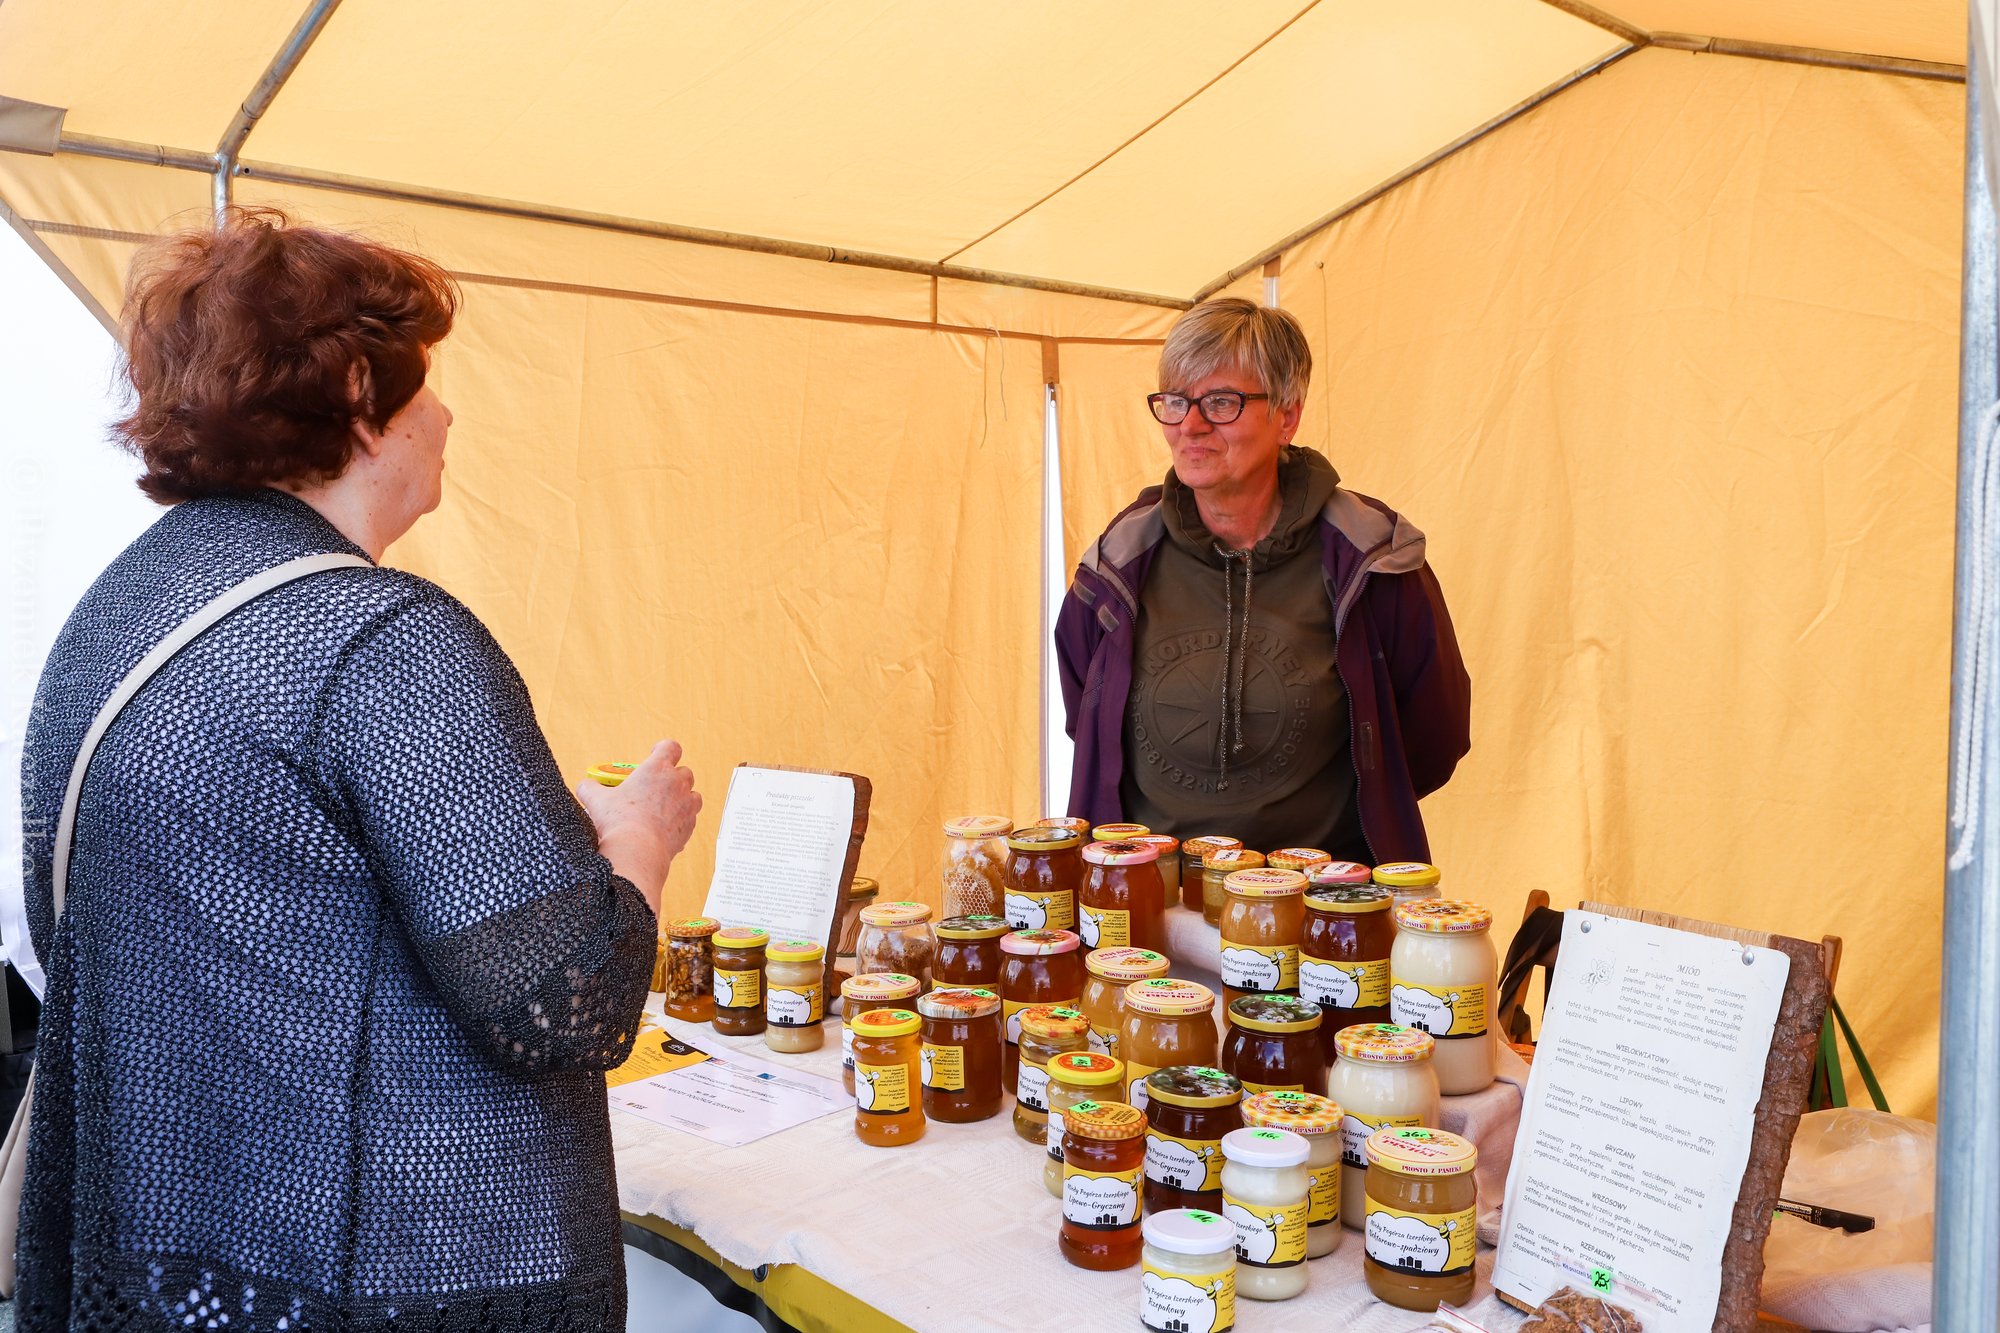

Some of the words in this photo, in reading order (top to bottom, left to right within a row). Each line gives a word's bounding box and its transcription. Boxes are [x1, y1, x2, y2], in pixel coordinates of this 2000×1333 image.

[1139, 630, 1312, 689] NORDRNEY
[1676, 963, 1701, 975] MIÓD
[1398, 1004, 1426, 1020] Rzepakowy
[1358, 1052, 1383, 1060] PROSTO
[1614, 1042, 1670, 1066] WIELOKWIATOWY
[1618, 1095, 1643, 1110] LIPOWY
[1604, 1142, 1636, 1161] GRYCZANY
[1401, 1165, 1428, 1174] PROSTO
[1437, 1166, 1462, 1174] PASIEKI
[1079, 1189, 1101, 1198] Pogórza
[1103, 1191, 1129, 1199] Izerskiego
[1590, 1190, 1627, 1212] WRZOSOWY
[1068, 1195, 1125, 1212] Lipowo-Gryczany
[1383, 1227, 1405, 1238] Pogórza
[1406, 1233, 1437, 1244] Izerskiego
[1579, 1239, 1616, 1263] RZEPAKOWY
[1151, 1288, 1171, 1300] Pogórza
[1173, 1295, 1204, 1305] Izerskiego
[1148, 1297, 1186, 1317] Rzepakowy
